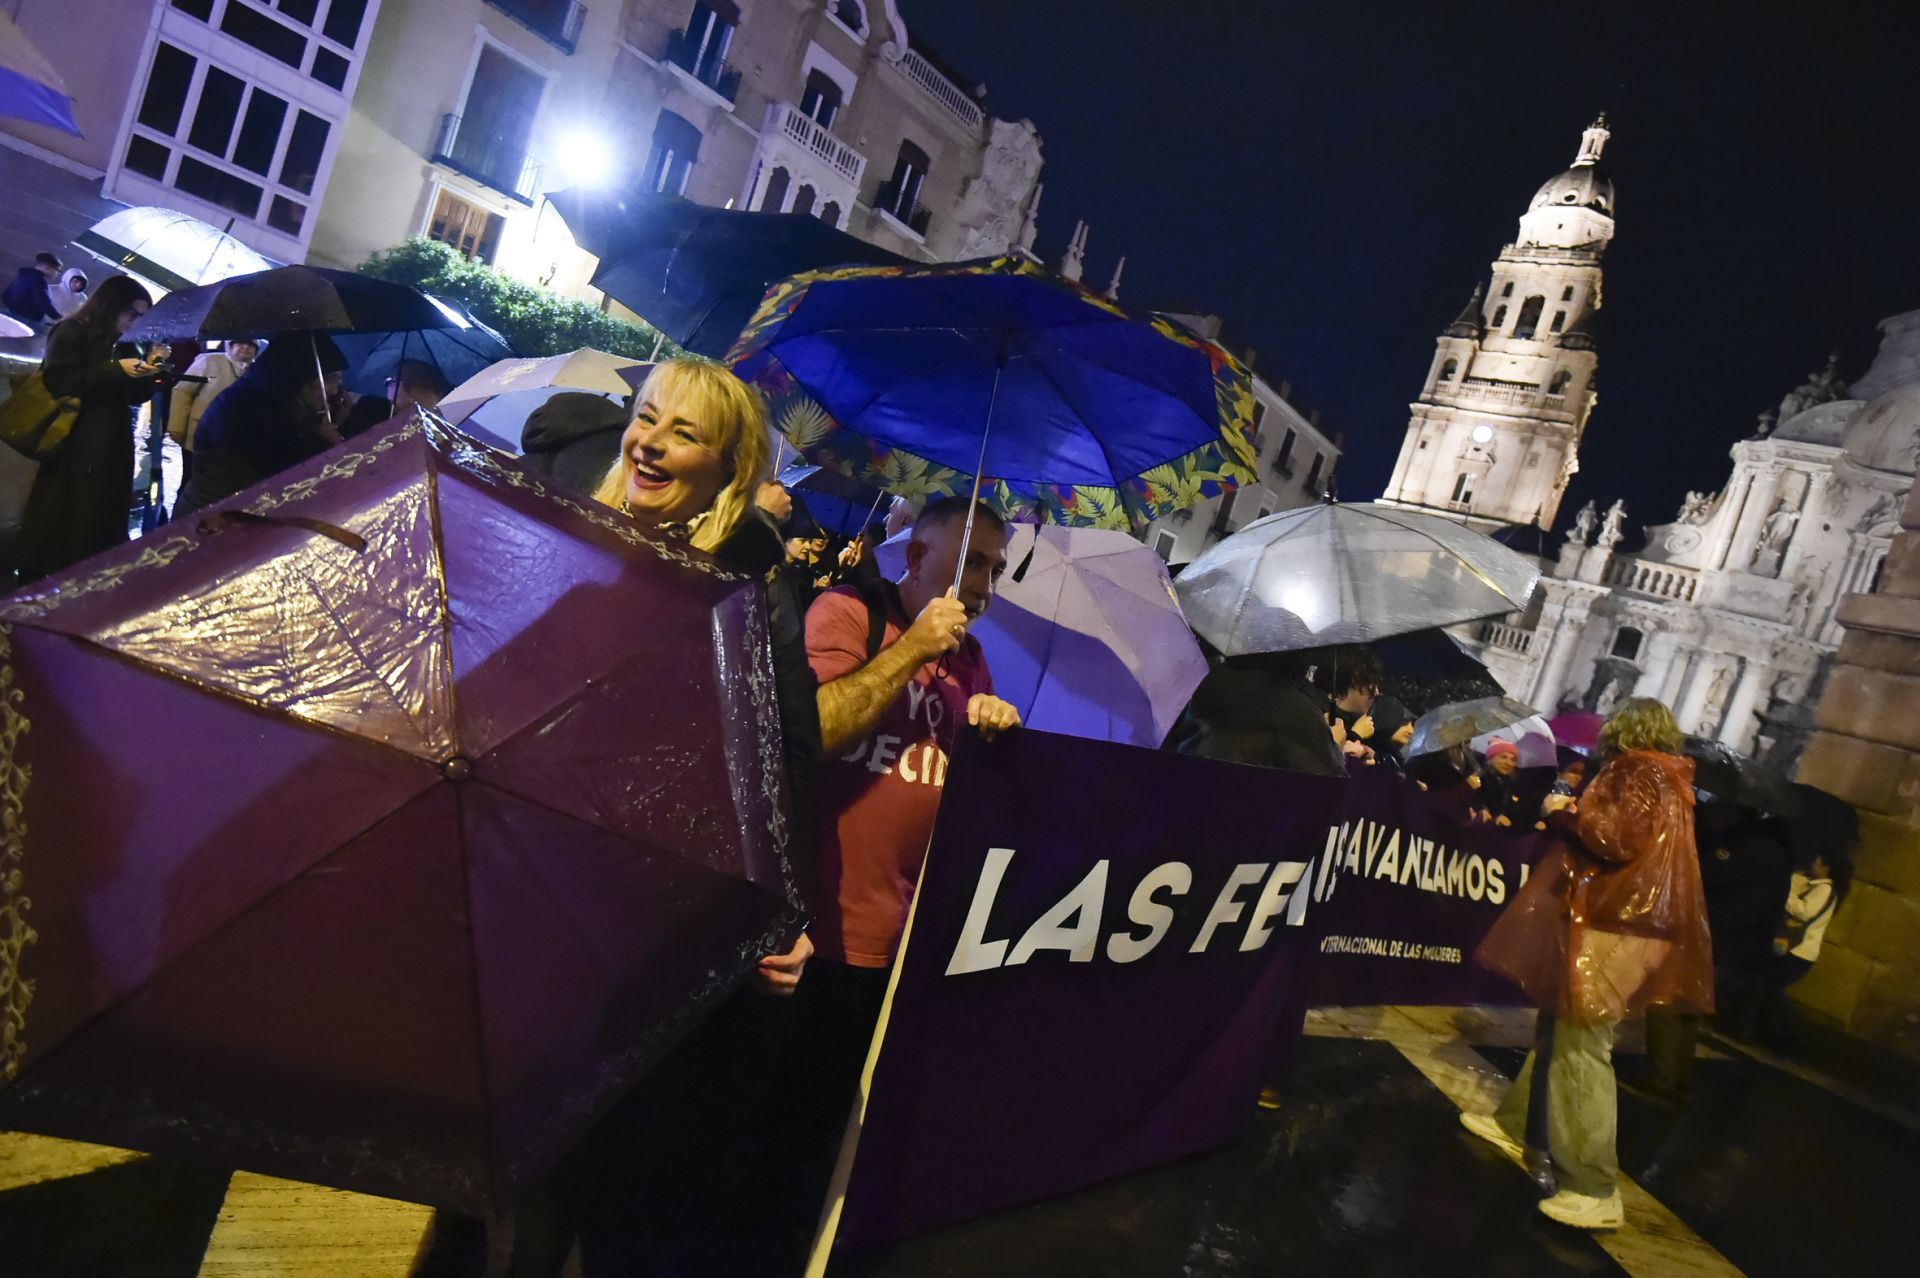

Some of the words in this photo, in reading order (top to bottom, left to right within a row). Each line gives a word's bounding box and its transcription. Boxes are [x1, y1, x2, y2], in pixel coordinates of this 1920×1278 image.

[907, 679, 944, 729] YO
[945, 848, 1191, 976] LAS
[1343, 817, 1506, 905] AVANZAMOS
[1389, 940, 1404, 958] DE
[1402, 942, 1422, 960] LAS
[1422, 944, 1462, 964] MUJERES
